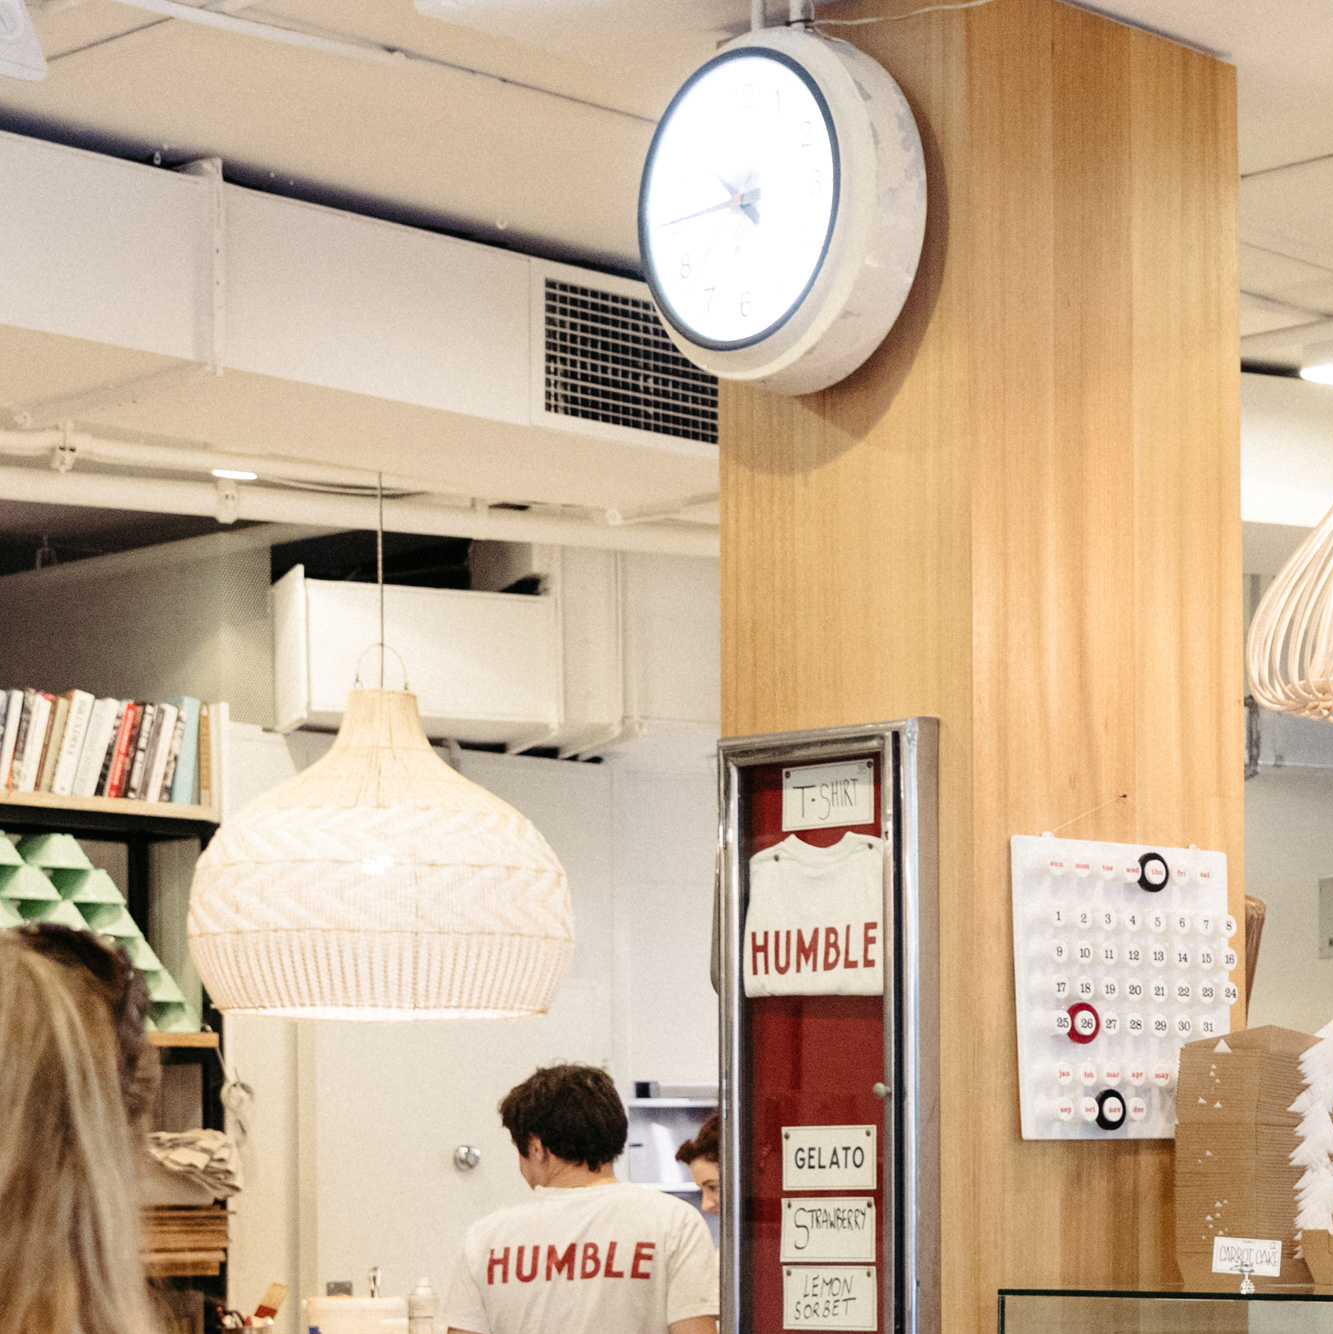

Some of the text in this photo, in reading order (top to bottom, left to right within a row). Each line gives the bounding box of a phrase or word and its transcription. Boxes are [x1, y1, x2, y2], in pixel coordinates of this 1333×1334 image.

[1129, 915, 1233, 931] 4 5 6 7 8
[751, 921, 878, 976] HUMBLE
[1056, 946, 1235, 965] 9 10 11 12 13 14 15 16
[1056, 982, 1237, 999] 17 18 19 20 21 22 23 24
[1056, 1017, 1214, 1032] 25 26 27 28 29 30 31
[794, 1146, 865, 1170] GELATO
[793, 1207, 867, 1250] STRAWBERRY
[487, 1241, 656, 1285] HUMBLE
[1219, 1245, 1254, 1264] CARROT
[1255, 1249, 1278, 1267] CAKE
[803, 1275, 854, 1298] LEMON
[794, 1297, 857, 1320] SORBET
